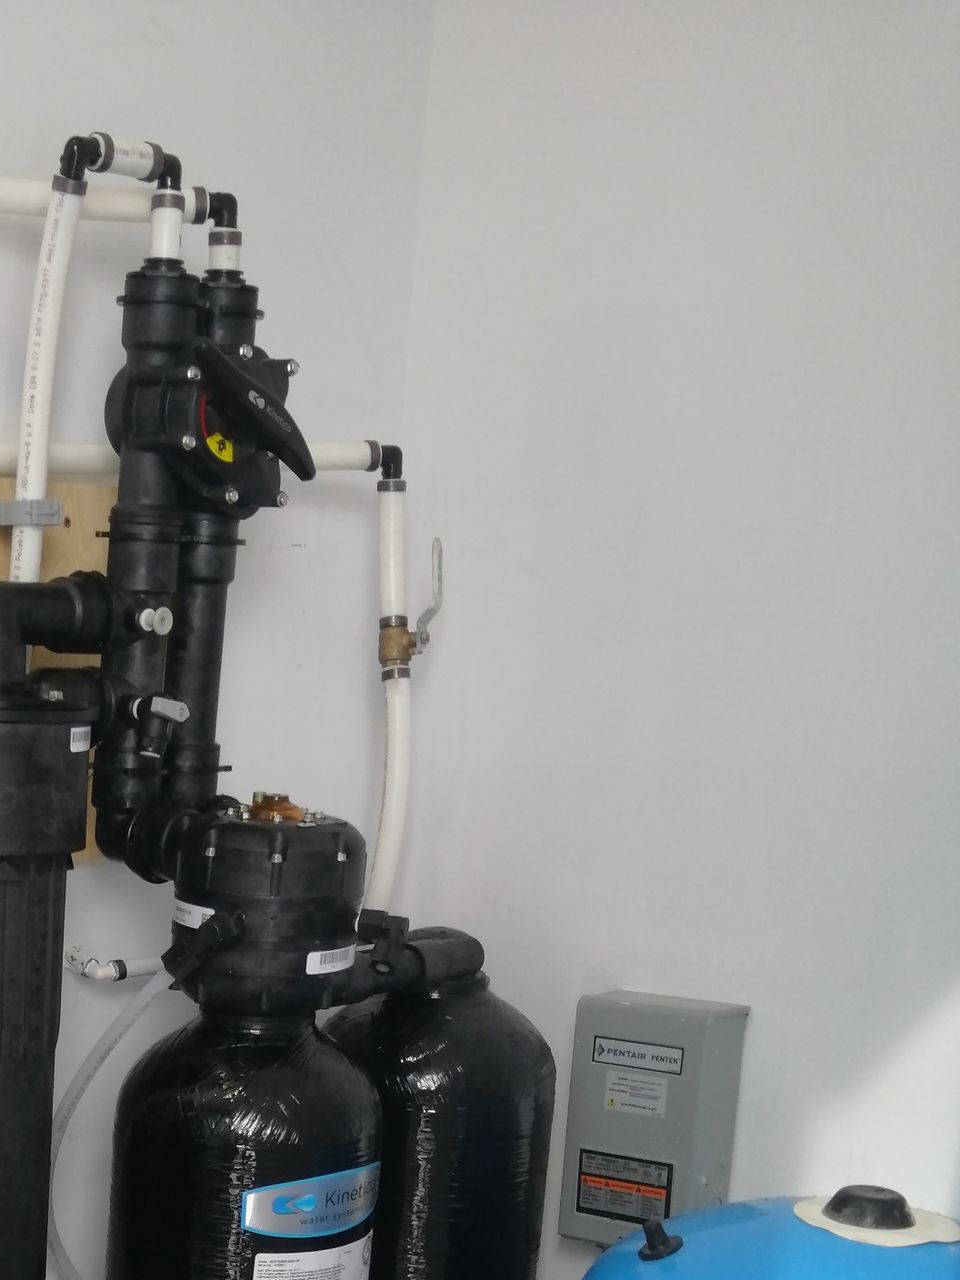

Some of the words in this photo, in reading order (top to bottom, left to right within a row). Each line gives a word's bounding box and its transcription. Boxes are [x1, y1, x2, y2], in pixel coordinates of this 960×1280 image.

[607, 1047, 647, 1061] PENTAIR
[651, 1054, 679, 1065] PENTEK
[299, 1214, 329, 1226] water
